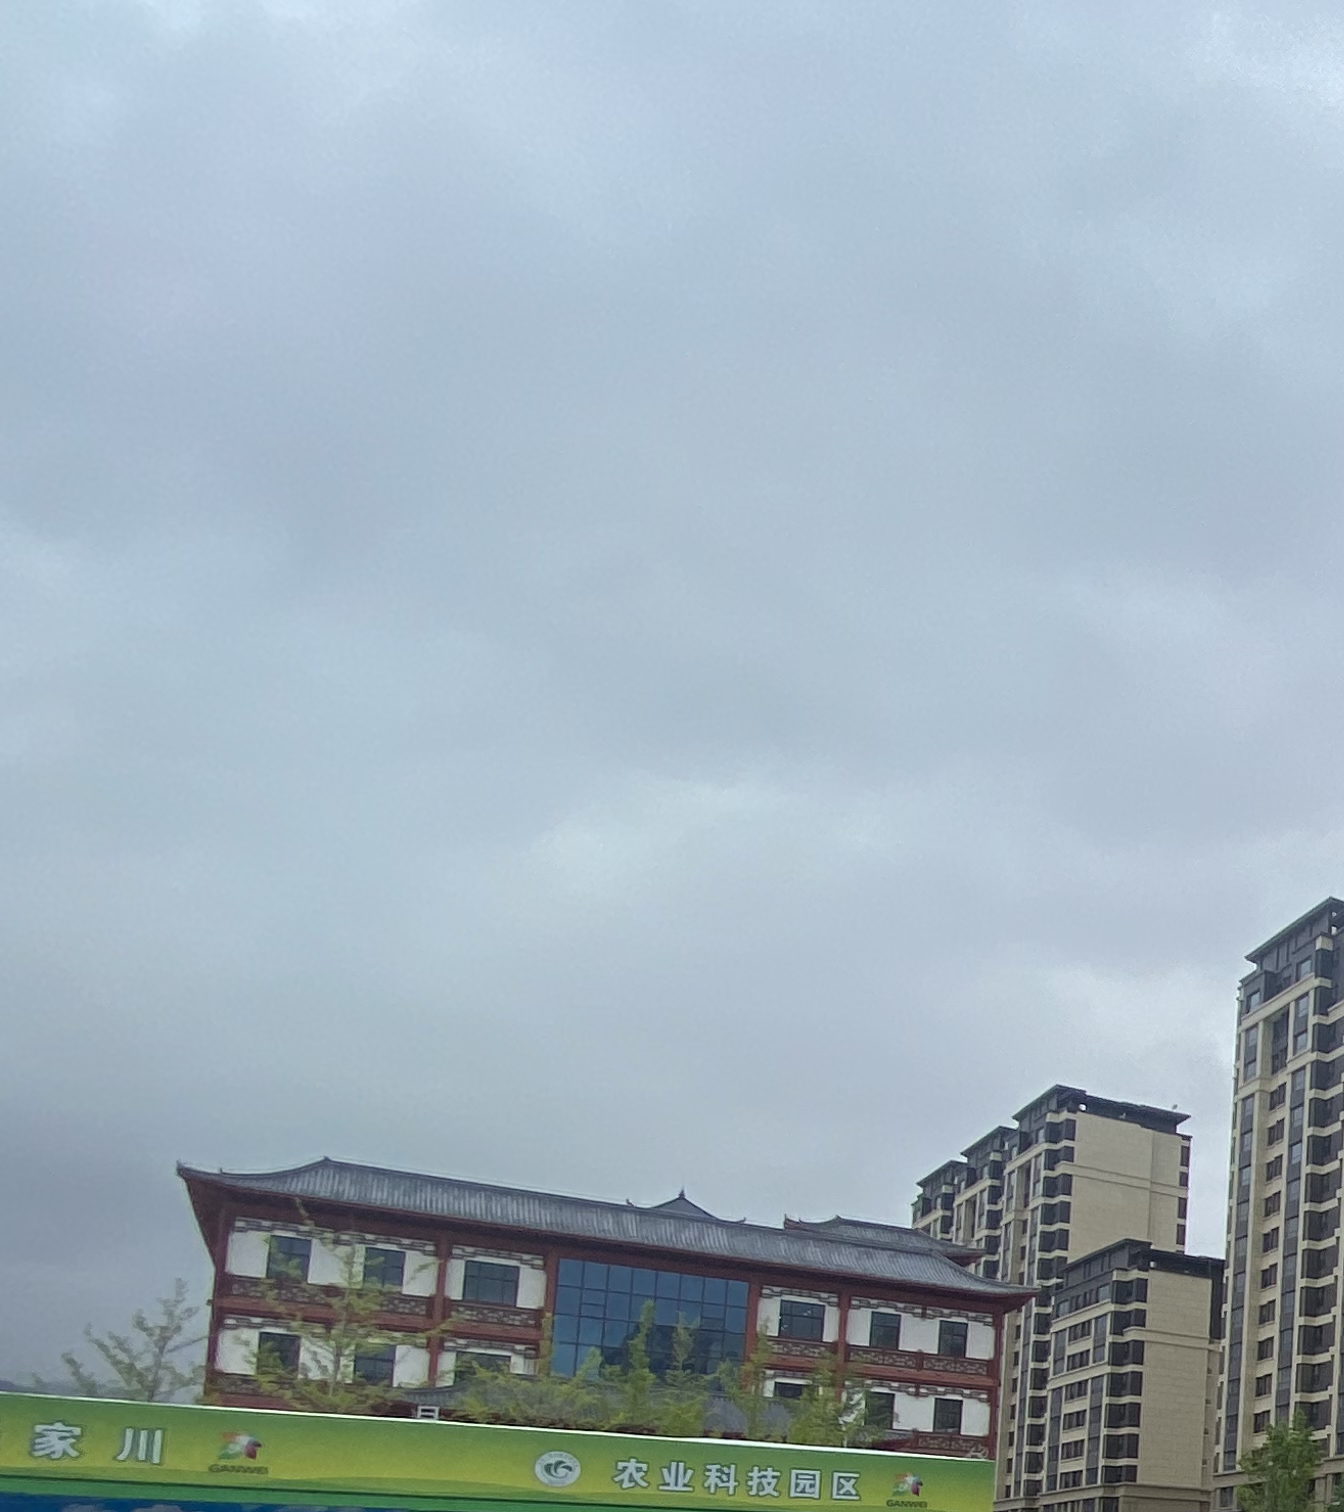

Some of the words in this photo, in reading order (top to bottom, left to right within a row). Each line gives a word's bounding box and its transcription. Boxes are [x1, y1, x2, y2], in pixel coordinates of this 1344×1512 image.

[612, 1457, 862, 1501] 农业科技园区
